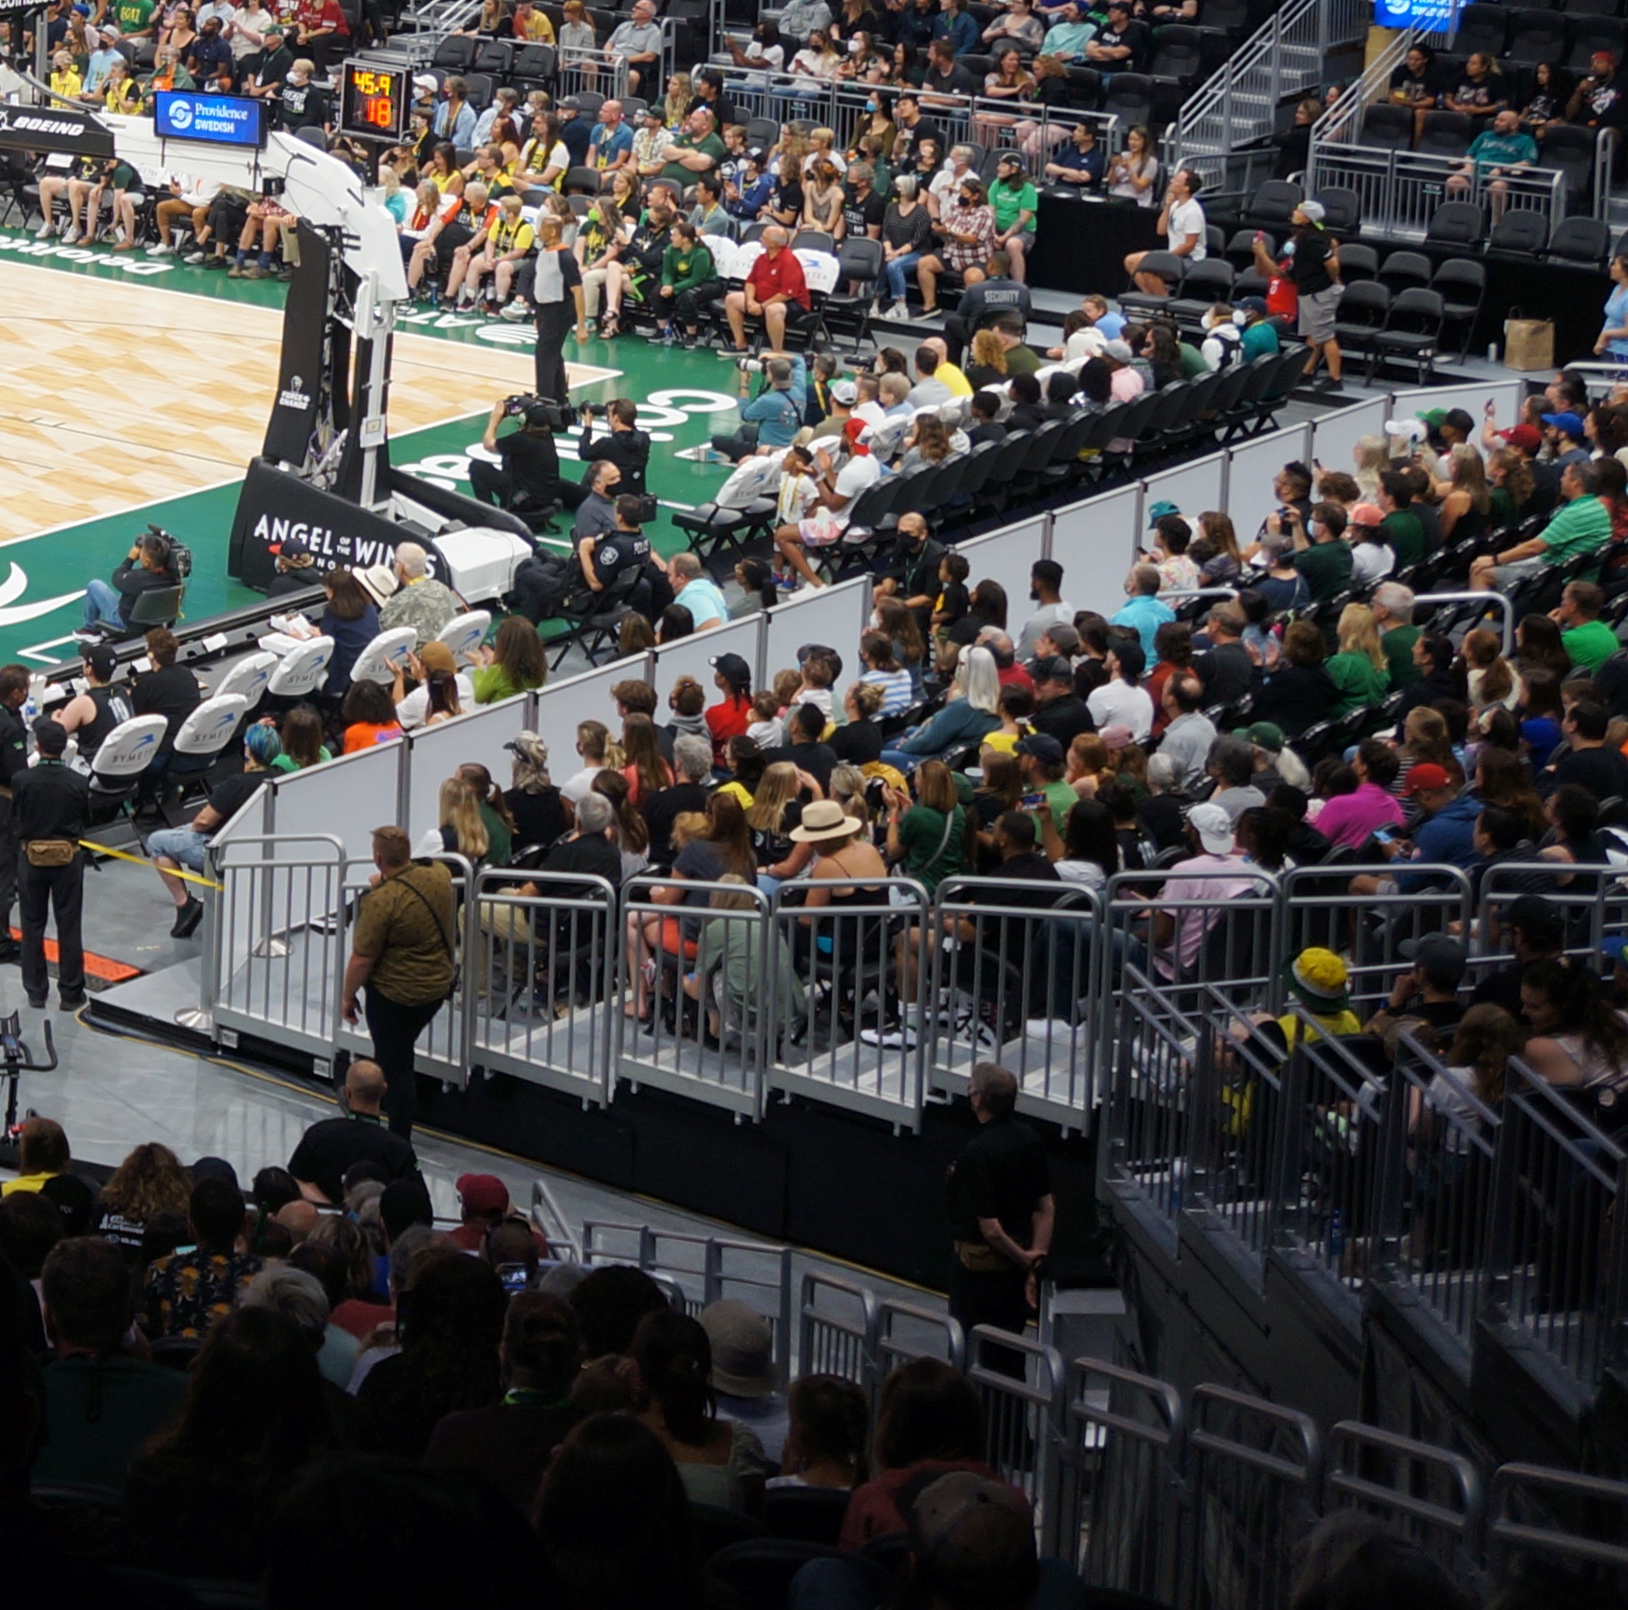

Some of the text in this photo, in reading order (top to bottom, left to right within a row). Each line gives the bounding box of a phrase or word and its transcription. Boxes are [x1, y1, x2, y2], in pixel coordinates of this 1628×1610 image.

[353, 71, 392, 96] 45.9
[195, 103, 248, 121] Providence
[367, 97, 392, 128] 18
[13, 115, 85, 137] BOEING
[195, 120, 234, 133] SWEDISH
[983, 289, 1019, 305] SECURITY
[254, 514, 333, 555] ANGEL
[339, 537, 350, 545] OF
[336, 544, 350, 555] THE
[355, 538, 437, 579] WINS
